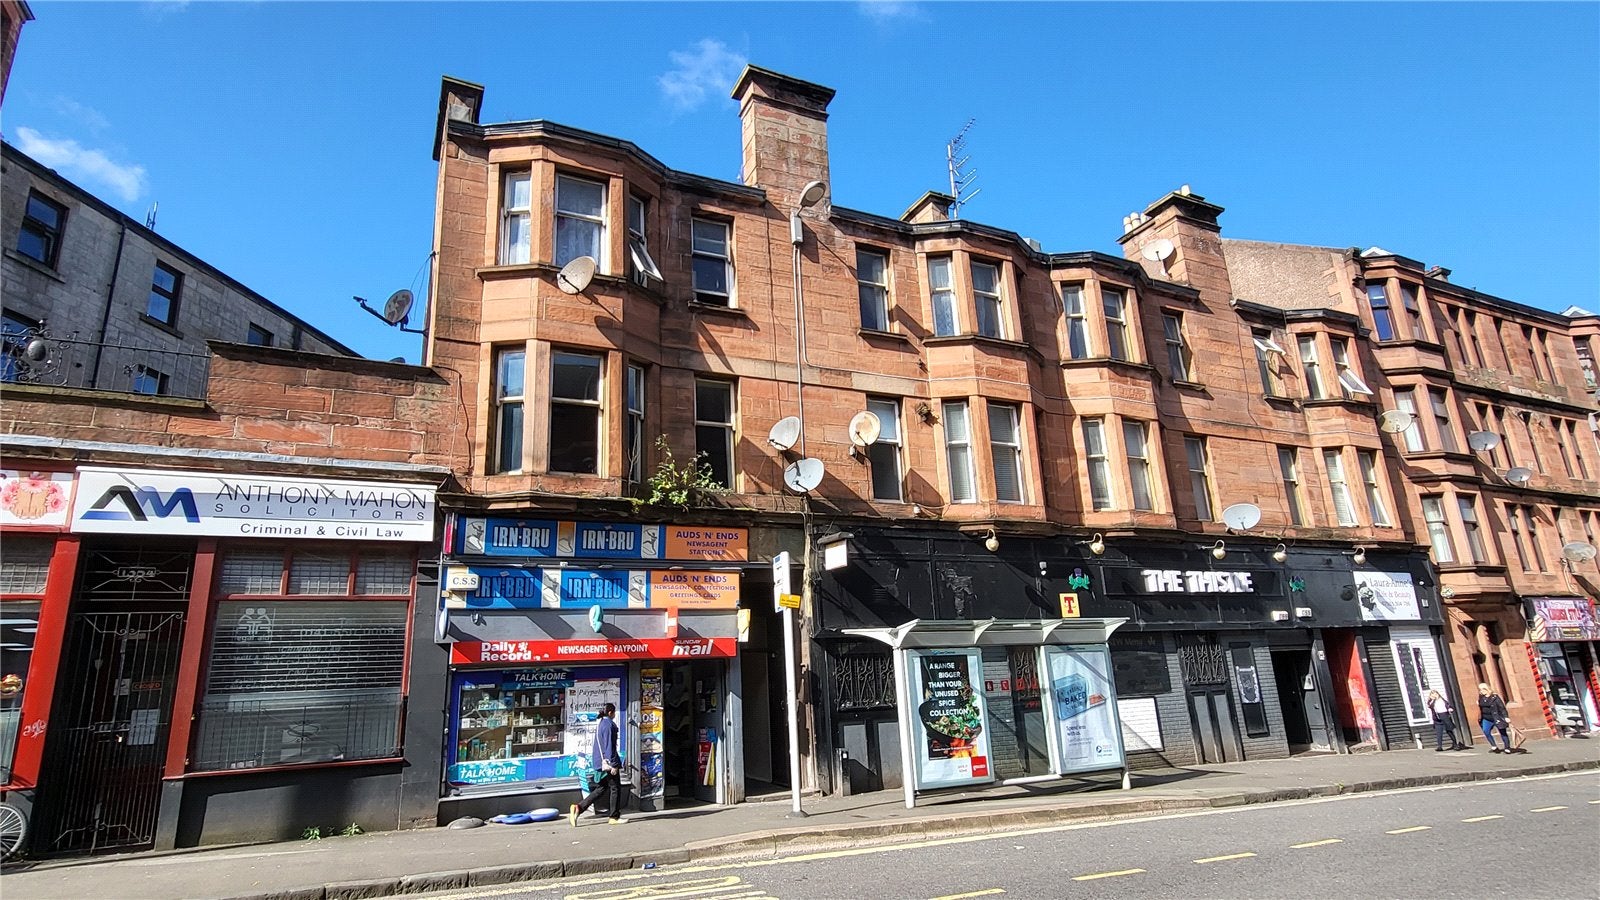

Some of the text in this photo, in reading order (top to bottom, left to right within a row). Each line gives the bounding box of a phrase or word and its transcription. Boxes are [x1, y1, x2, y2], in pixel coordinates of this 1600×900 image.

[215, 483, 426, 509] ANTHONY MAHON
[214, 503, 425, 520] SOLICITORS
[240, 523, 404, 537] Criminal & Civil Law
[676, 531, 701, 539] AUDS
[716, 532, 739, 540] ENDS
[662, 575, 688, 583] AUDS
[1142, 569, 1184, 593] THE
[1063, 596, 1075, 614] T
[481, 641, 517, 654] Daily
[557, 645, 608, 655] NEWSAGENTS
[613, 643, 649, 654] PAYPOINT
[672, 639, 714, 656] mail
[481, 650, 531, 662] Record
[515, 672, 567, 682] TALK HOME
[938, 671, 961, 679] BIGGER
[928, 681, 945, 689] THAN
[929, 708, 969, 717] COLLECTION
[489, 766, 517, 776] HOME
